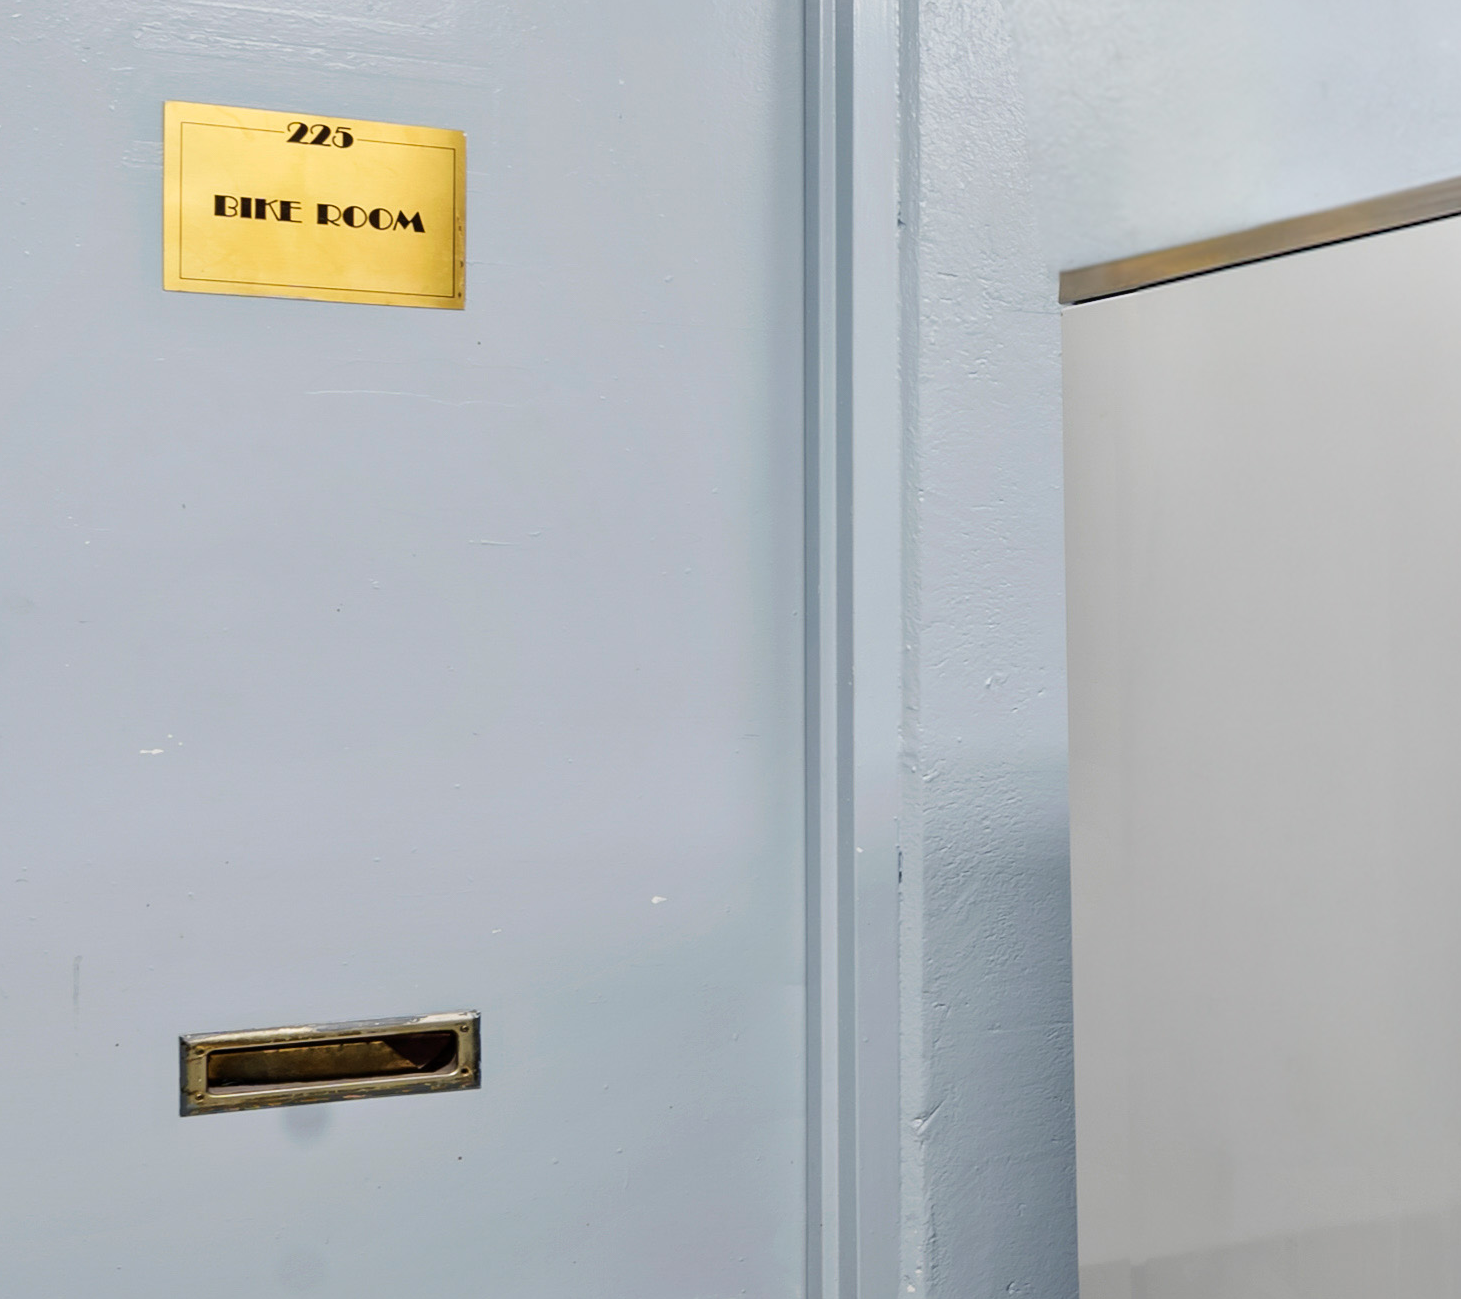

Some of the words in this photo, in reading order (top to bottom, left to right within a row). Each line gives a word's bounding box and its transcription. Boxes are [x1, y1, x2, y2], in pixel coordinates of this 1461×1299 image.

[285, 122, 354, 148] 225
[214, 195, 302, 224] BIKE
[316, 204, 426, 233] ROOM
